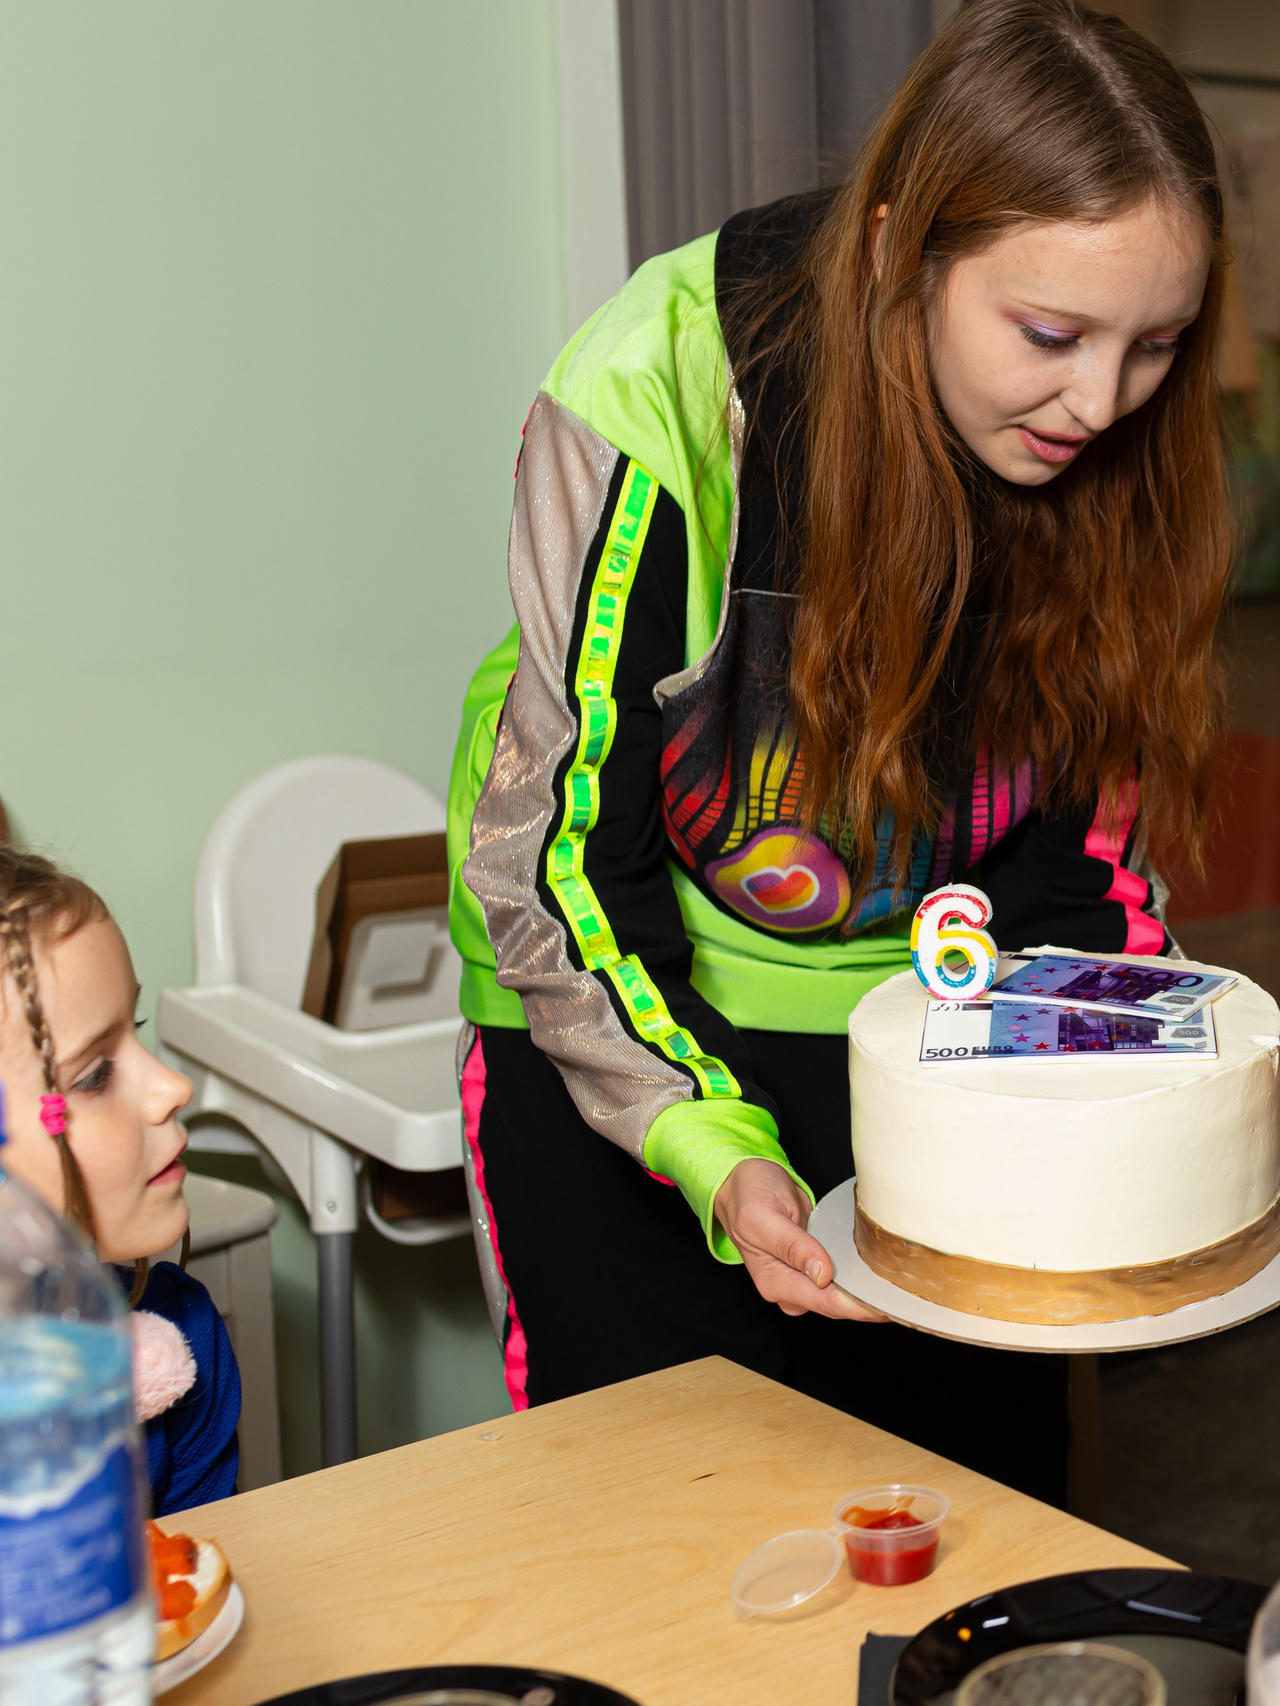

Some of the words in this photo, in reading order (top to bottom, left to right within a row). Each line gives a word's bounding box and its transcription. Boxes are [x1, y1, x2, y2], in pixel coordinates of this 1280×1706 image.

[910, 884, 998, 1001] 6
[1113, 966, 1204, 988] 500
[1169, 995, 1190, 1003] 500
[926, 1047, 968, 1058] 500
